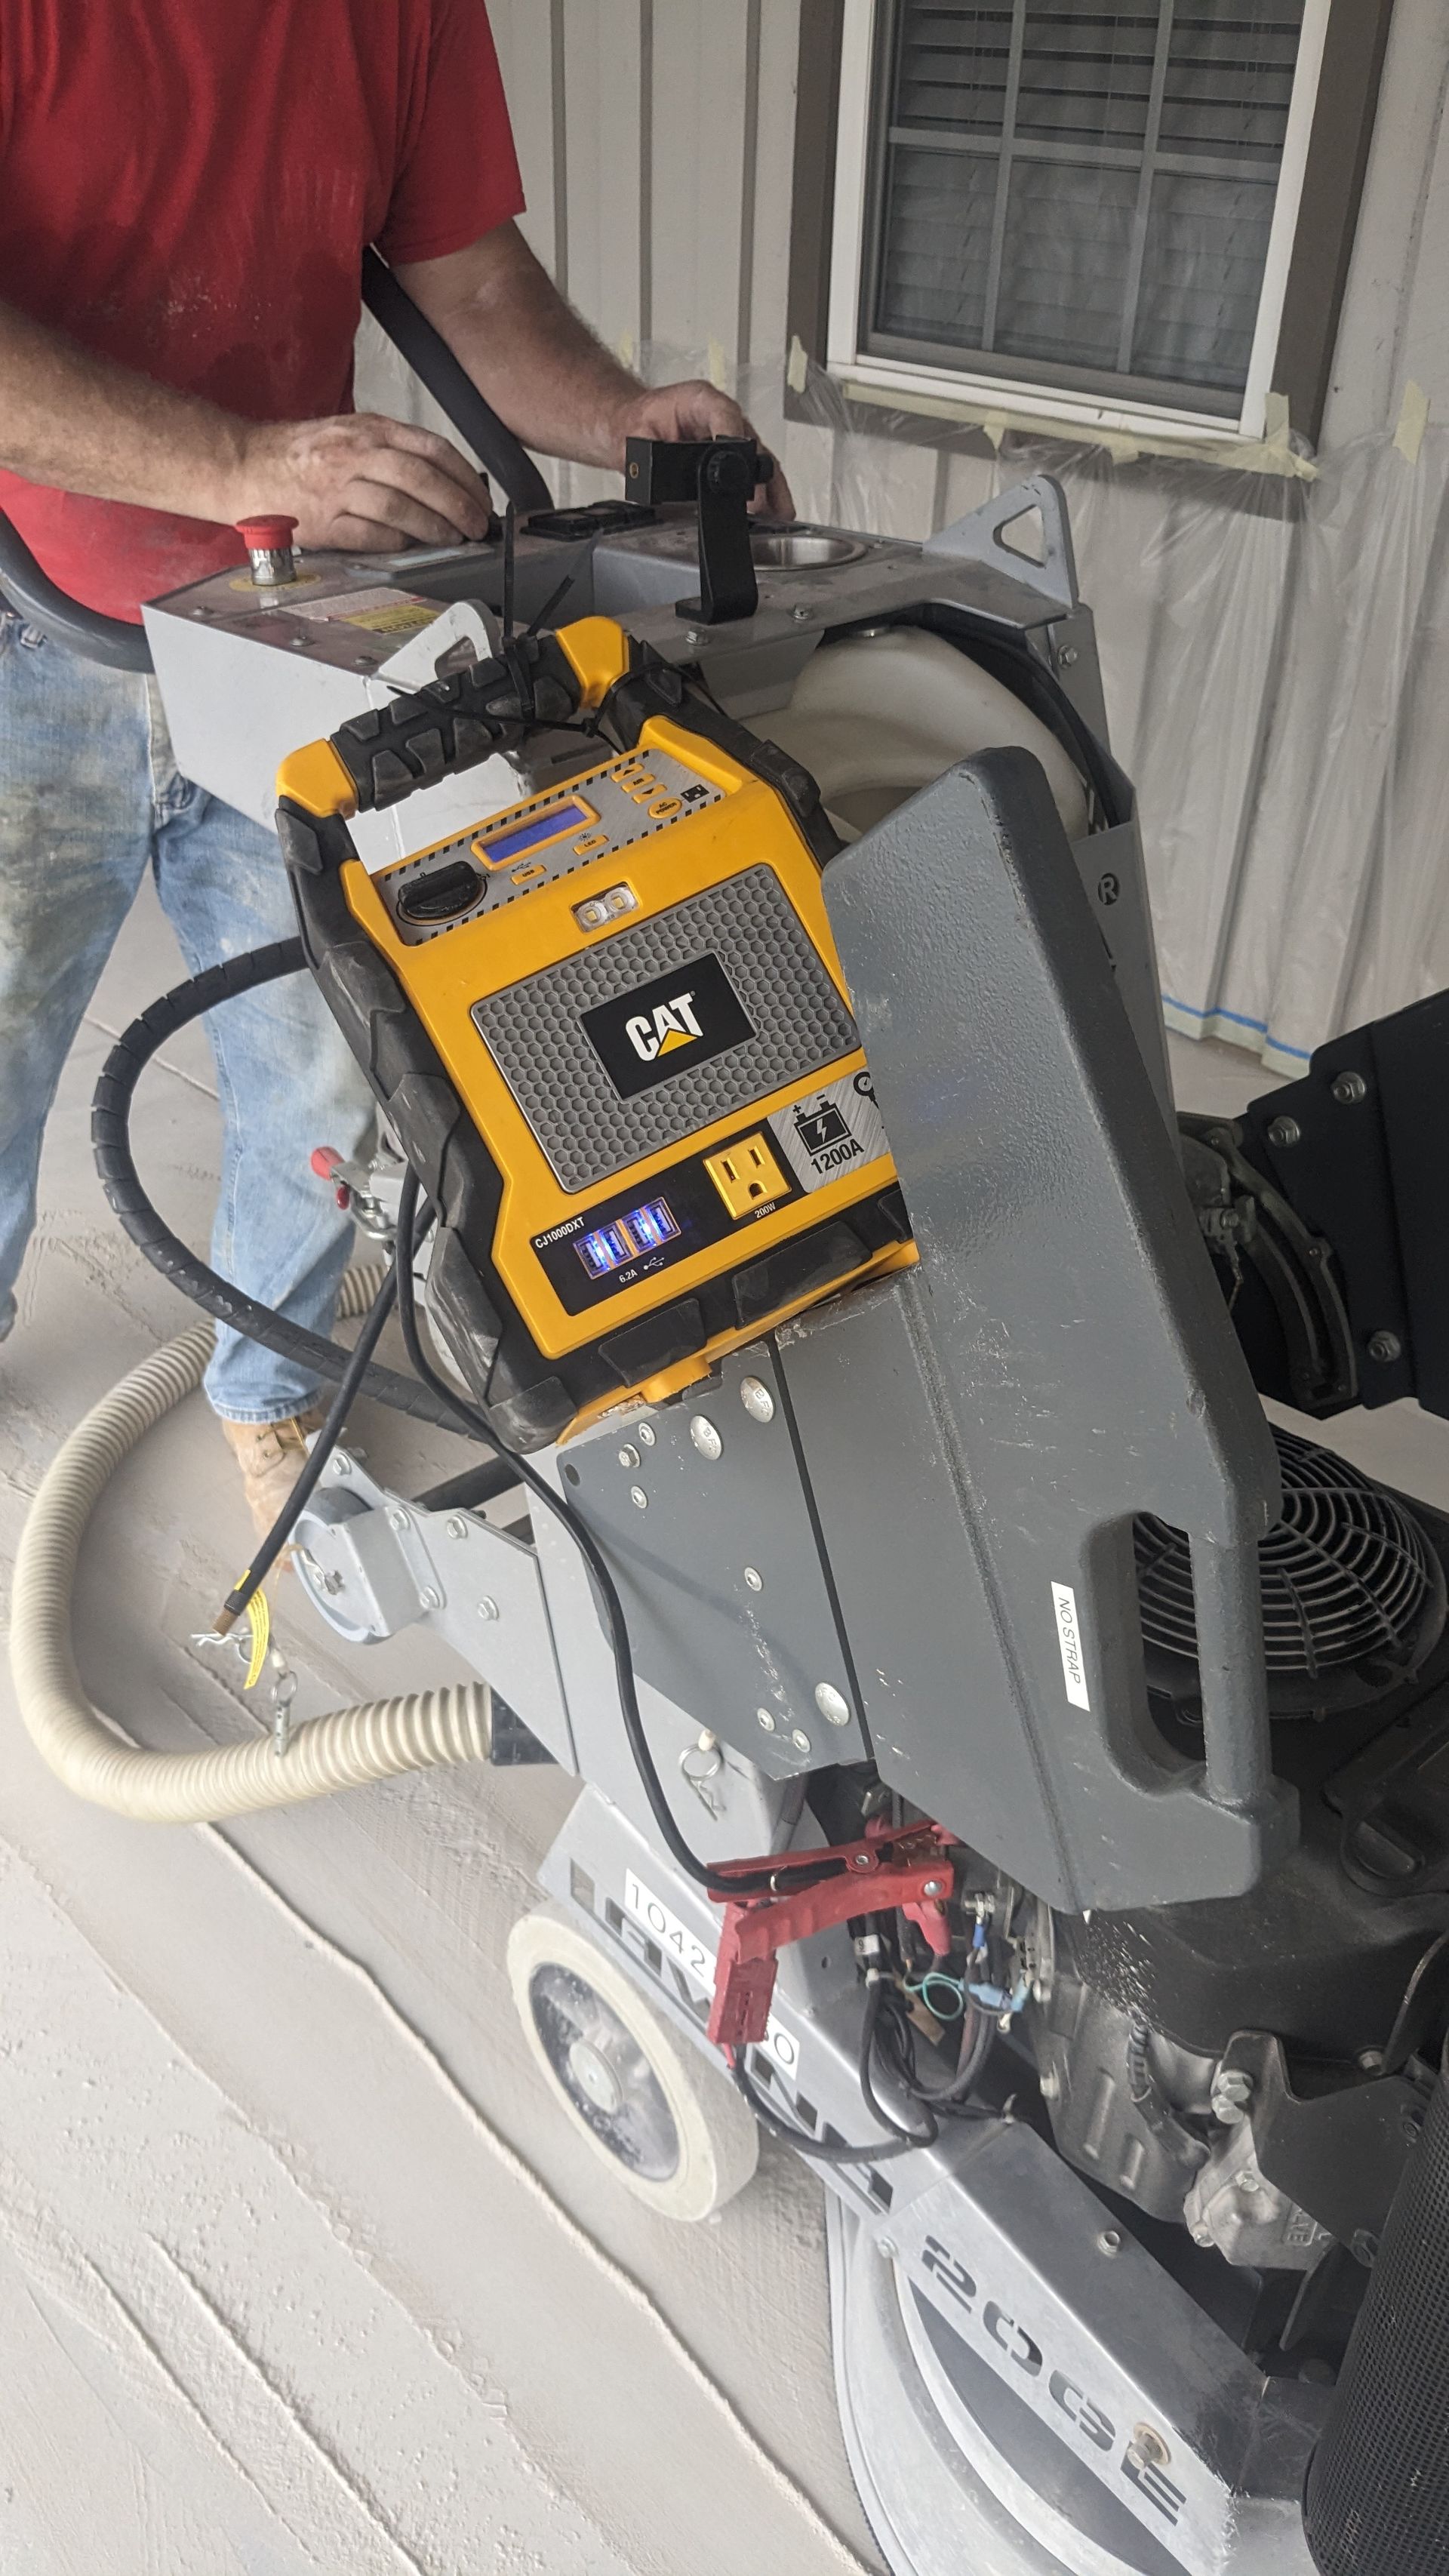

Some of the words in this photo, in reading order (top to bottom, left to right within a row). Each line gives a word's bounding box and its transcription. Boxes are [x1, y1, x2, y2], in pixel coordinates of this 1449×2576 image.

[656, 802, 677, 814] POWER
[584, 839, 596, 848] LED
[522, 869, 535, 878] USB
[626, 993, 703, 1061] CAT
[811, 1138, 865, 1174] 1200A
[755, 1202, 776, 1218] 200W
[534, 1216, 585, 1249] CJ1000DXT
[618, 1268, 638, 1284] 6.2A
[1058, 1597, 1072, 1623] NO
[1063, 1627, 1081, 1684] STRAP
